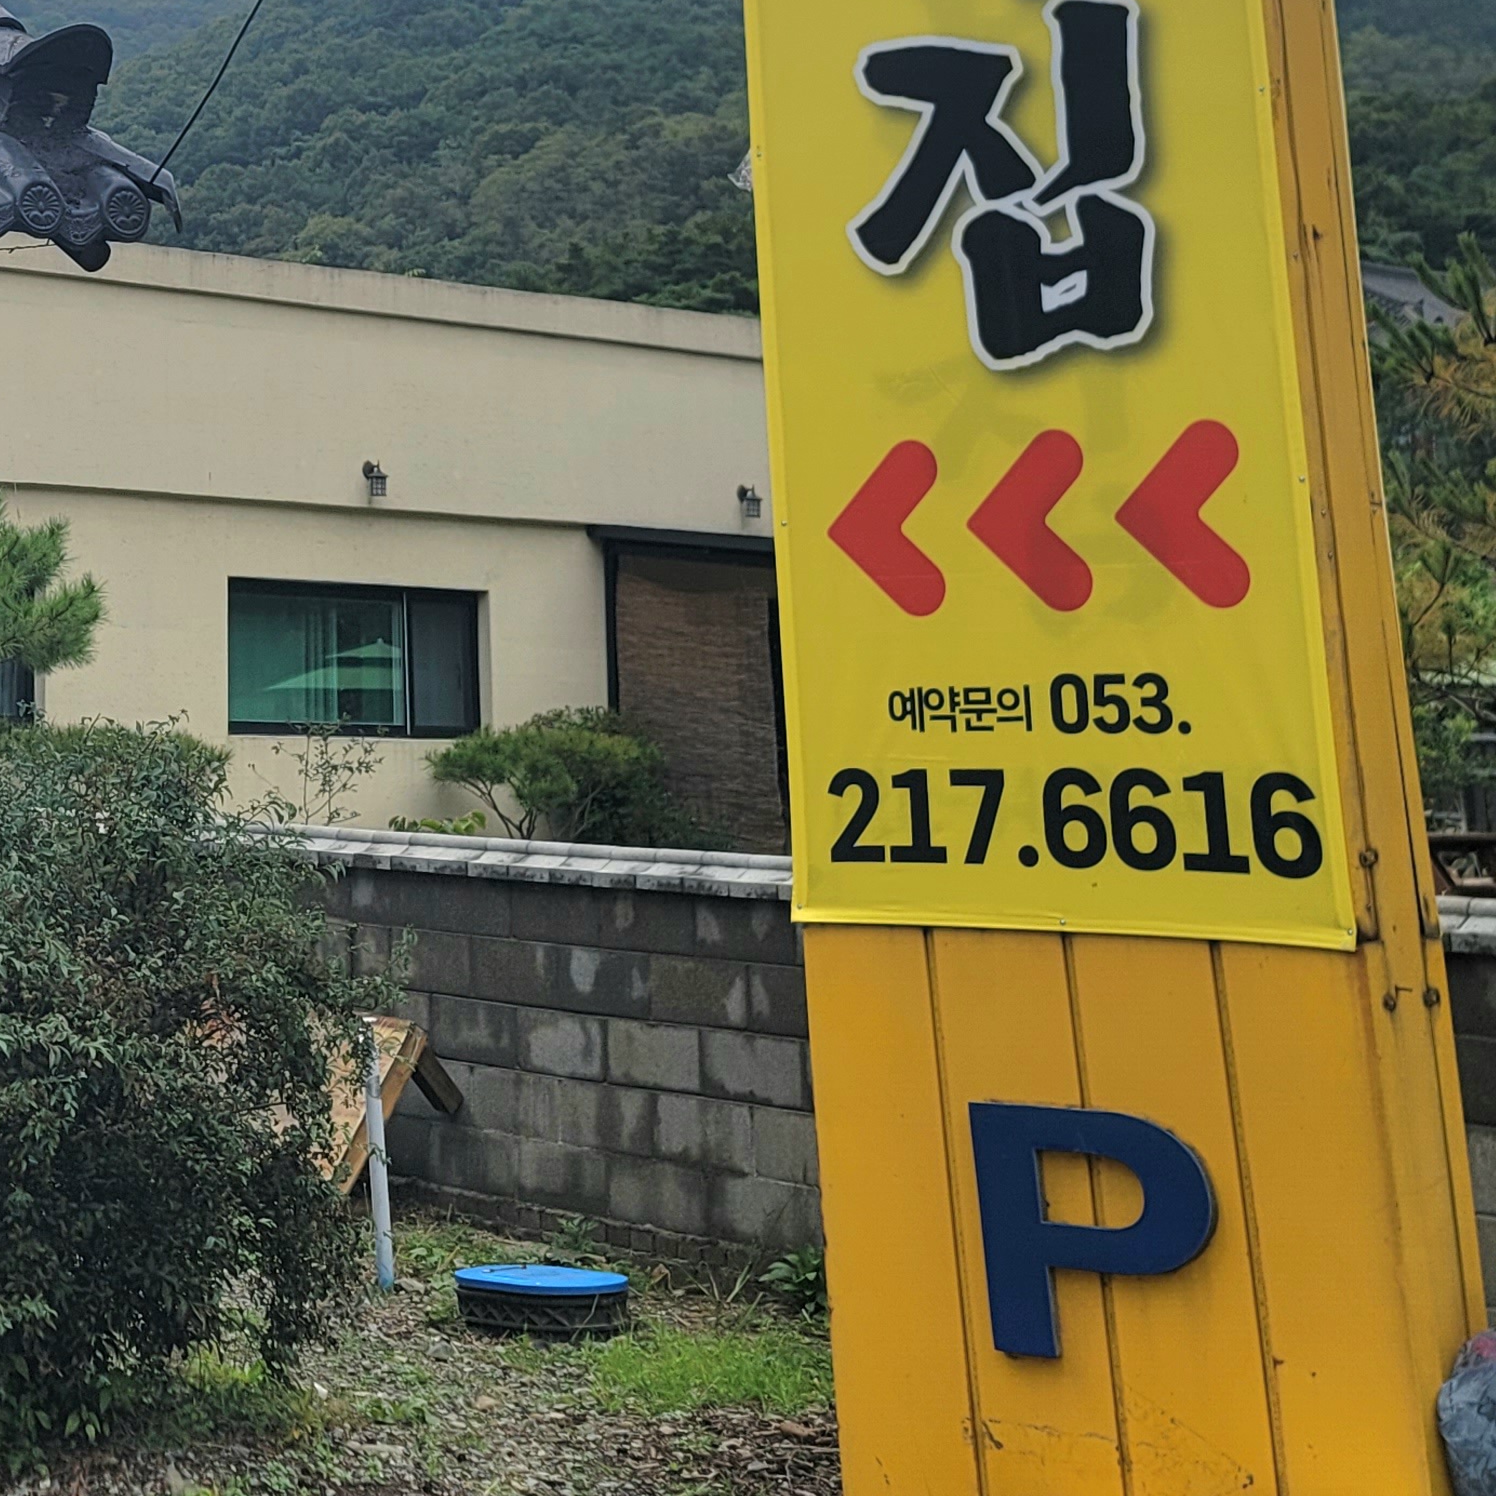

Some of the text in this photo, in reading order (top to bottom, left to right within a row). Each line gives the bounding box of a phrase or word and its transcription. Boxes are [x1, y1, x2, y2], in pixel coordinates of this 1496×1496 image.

[887, 672, 1192, 735] 예약문의 053.
[826, 766, 1324, 879] 217.6616
[968, 1101, 1218, 1358] P
